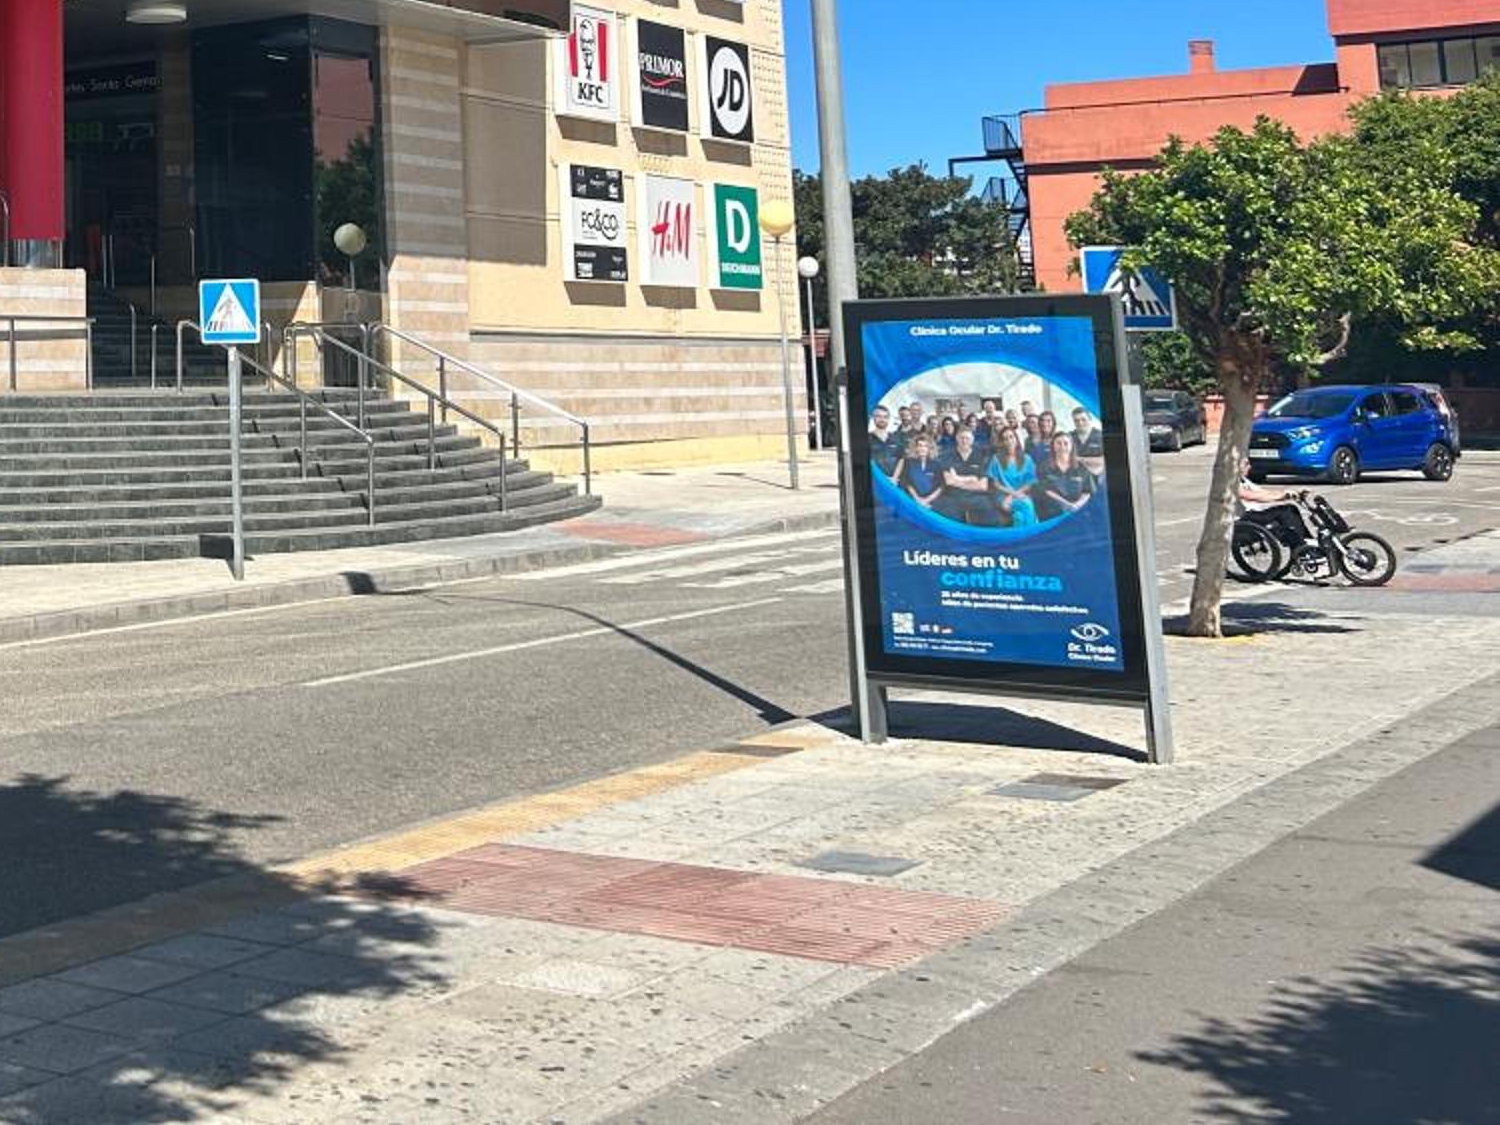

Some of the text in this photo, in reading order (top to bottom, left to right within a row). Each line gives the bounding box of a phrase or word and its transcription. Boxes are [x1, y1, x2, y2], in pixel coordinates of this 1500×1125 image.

[639, 52, 684, 78] PRIMOR
[578, 82, 604, 103] KFC
[717, 69, 745, 112] JD
[652, 201, 690, 261] H&M
[725, 199, 750, 253] D
[904, 551, 1020, 569] Líderes en tu
[940, 569, 1062, 592] confianza
